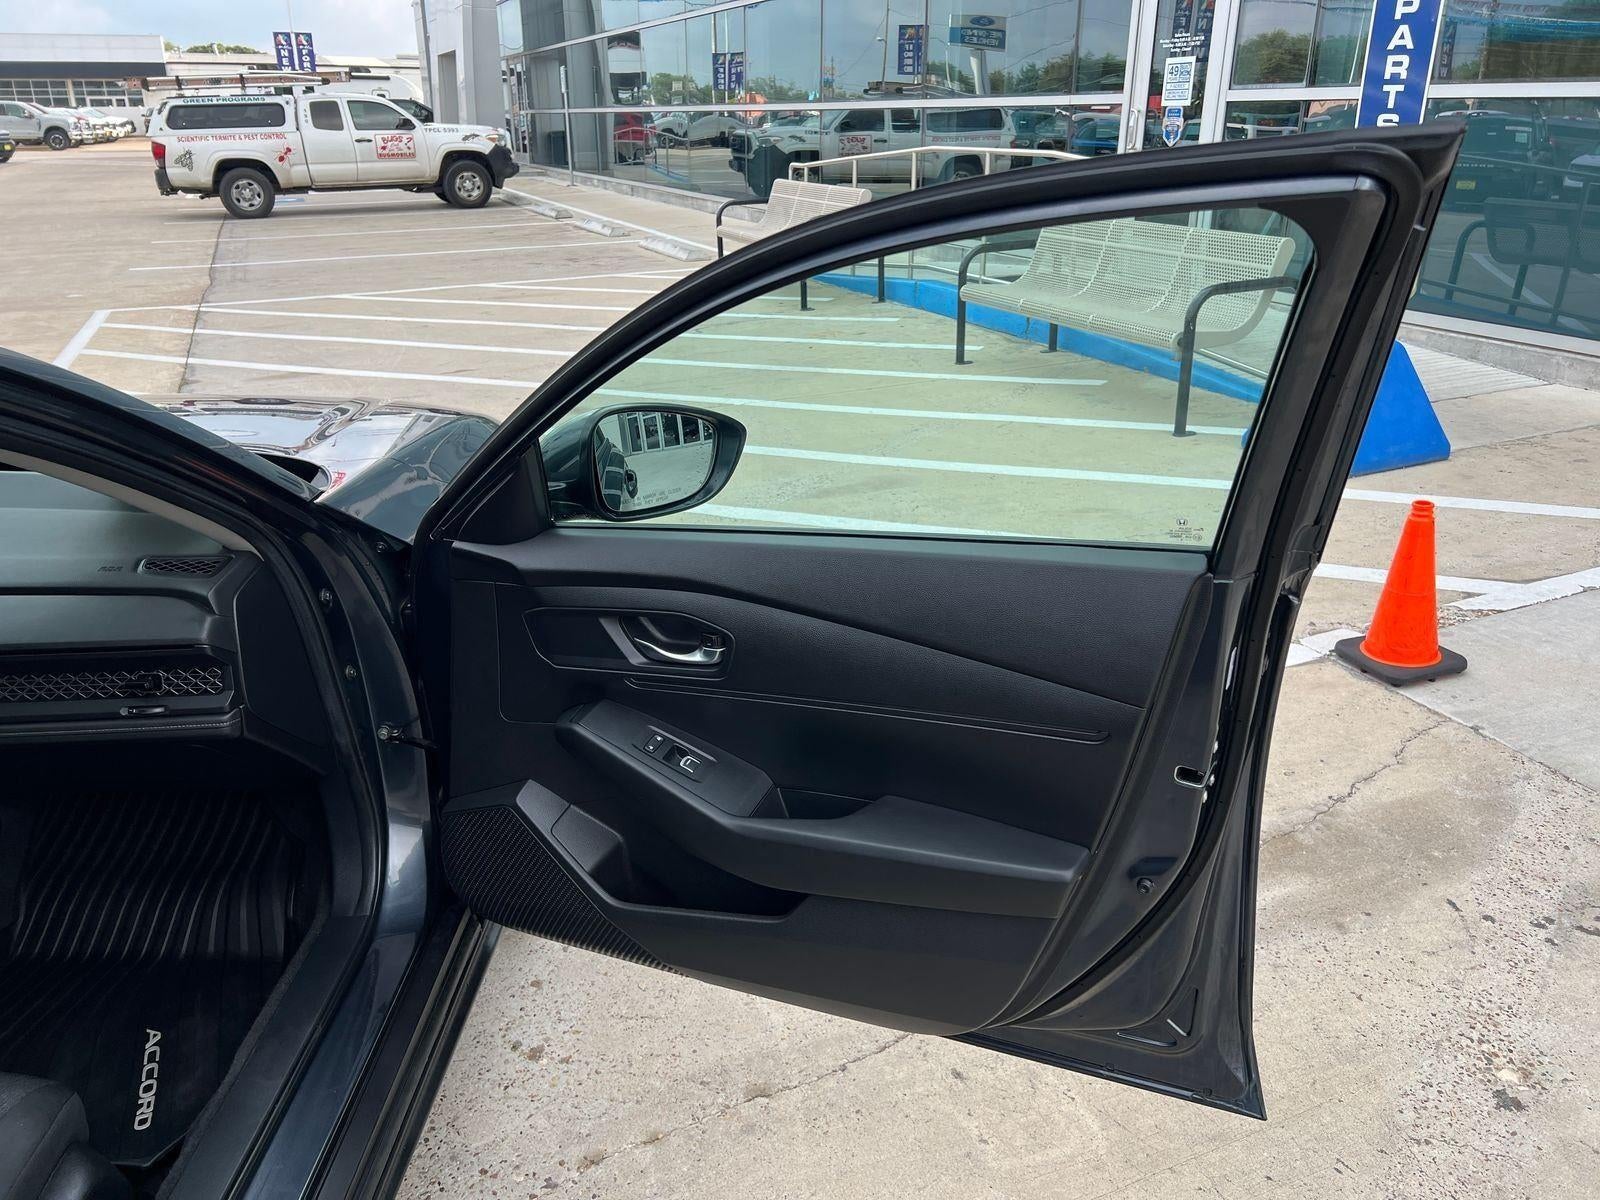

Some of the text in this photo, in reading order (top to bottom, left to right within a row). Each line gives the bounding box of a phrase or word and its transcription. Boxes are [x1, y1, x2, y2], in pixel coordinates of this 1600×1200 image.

[280, 49, 292, 71] NEW
[1377, 0, 1420, 127] PARTS
[1169, 66, 1179, 76] 49
[176, 135, 209, 143] SCIENTIFIC
[211, 134, 236, 142] TERMITE
[244, 133, 259, 141] PEST
[260, 132, 287, 140] CONTROL
[381, 135, 403, 144] BUGS
[134, 1029, 161, 1130] ACCORD
